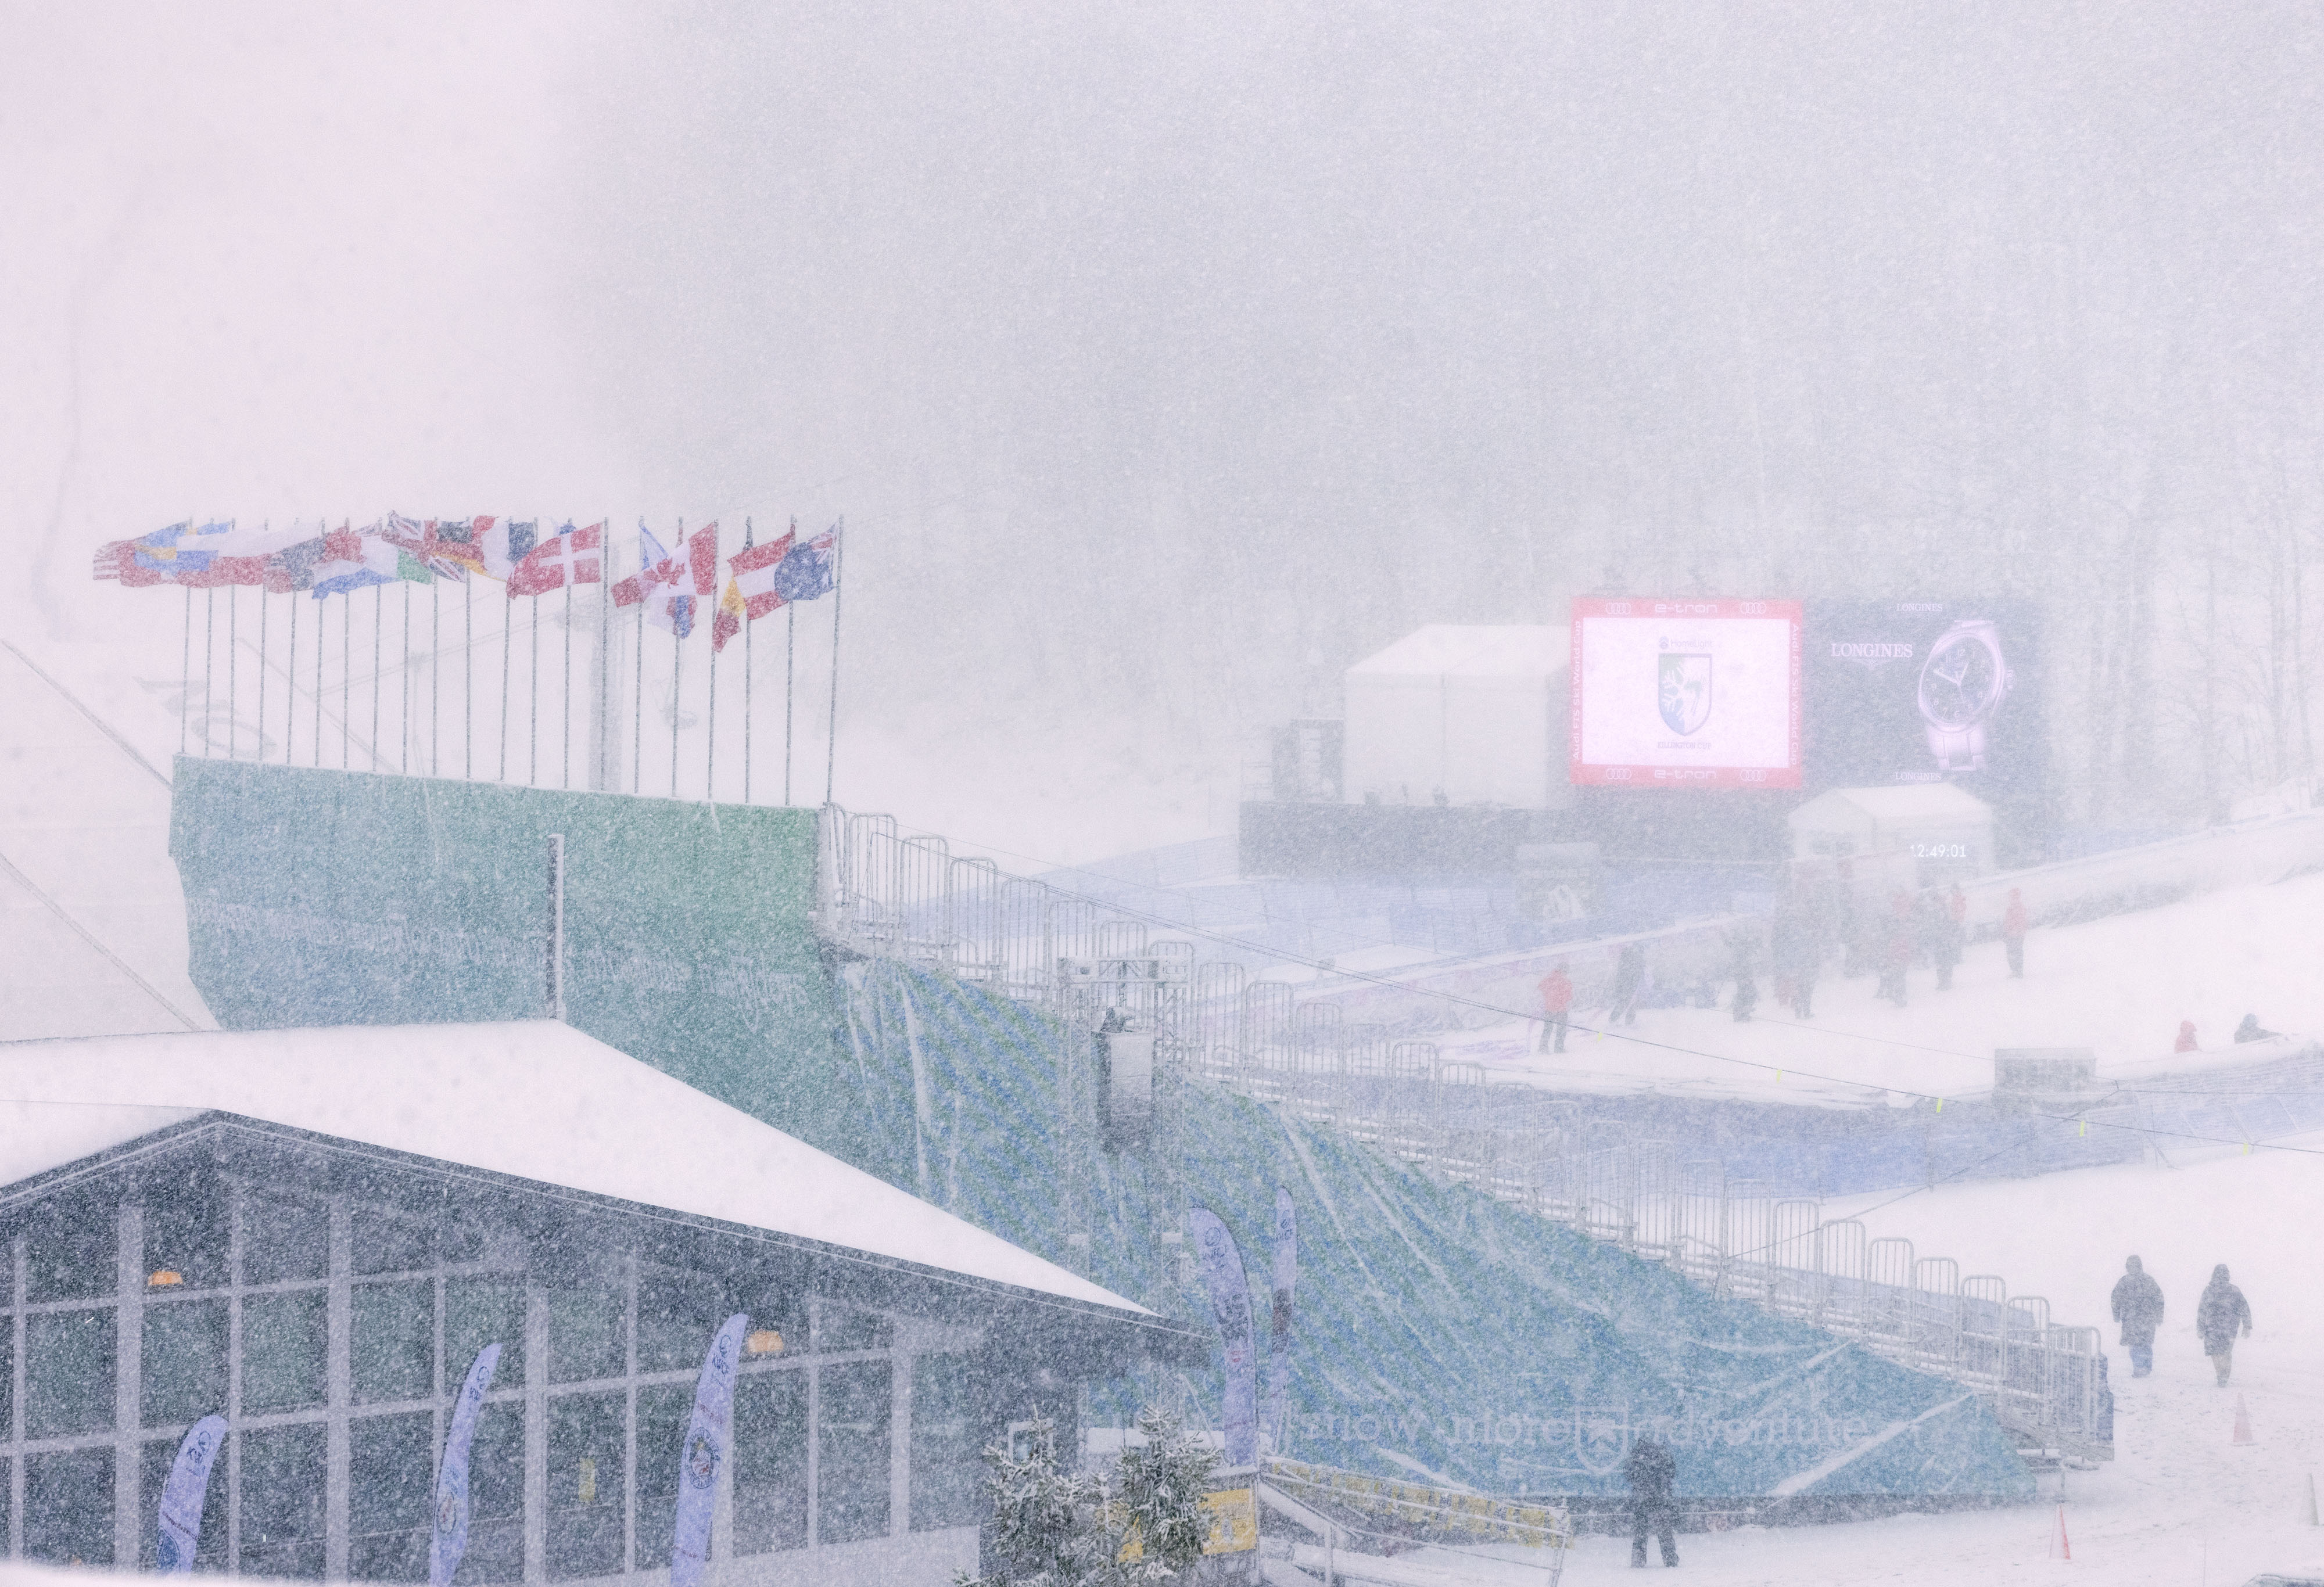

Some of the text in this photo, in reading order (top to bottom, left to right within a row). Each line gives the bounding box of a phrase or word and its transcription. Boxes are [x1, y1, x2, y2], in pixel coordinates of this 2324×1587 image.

[1655, 604, 1717, 613] e-tron
[1896, 604, 1943, 612] LONGINES
[1670, 638, 1712, 649] HomeLight
[1831, 643, 1913, 658] LONGINES
[1572, 621, 1581, 760] Audi FIS Ski World Cup
[1790, 624, 1800, 766] Audi FIS Ski World Cup
[1654, 769, 1716, 779] e-tron
[1895, 771, 1941, 781] LONGINES
